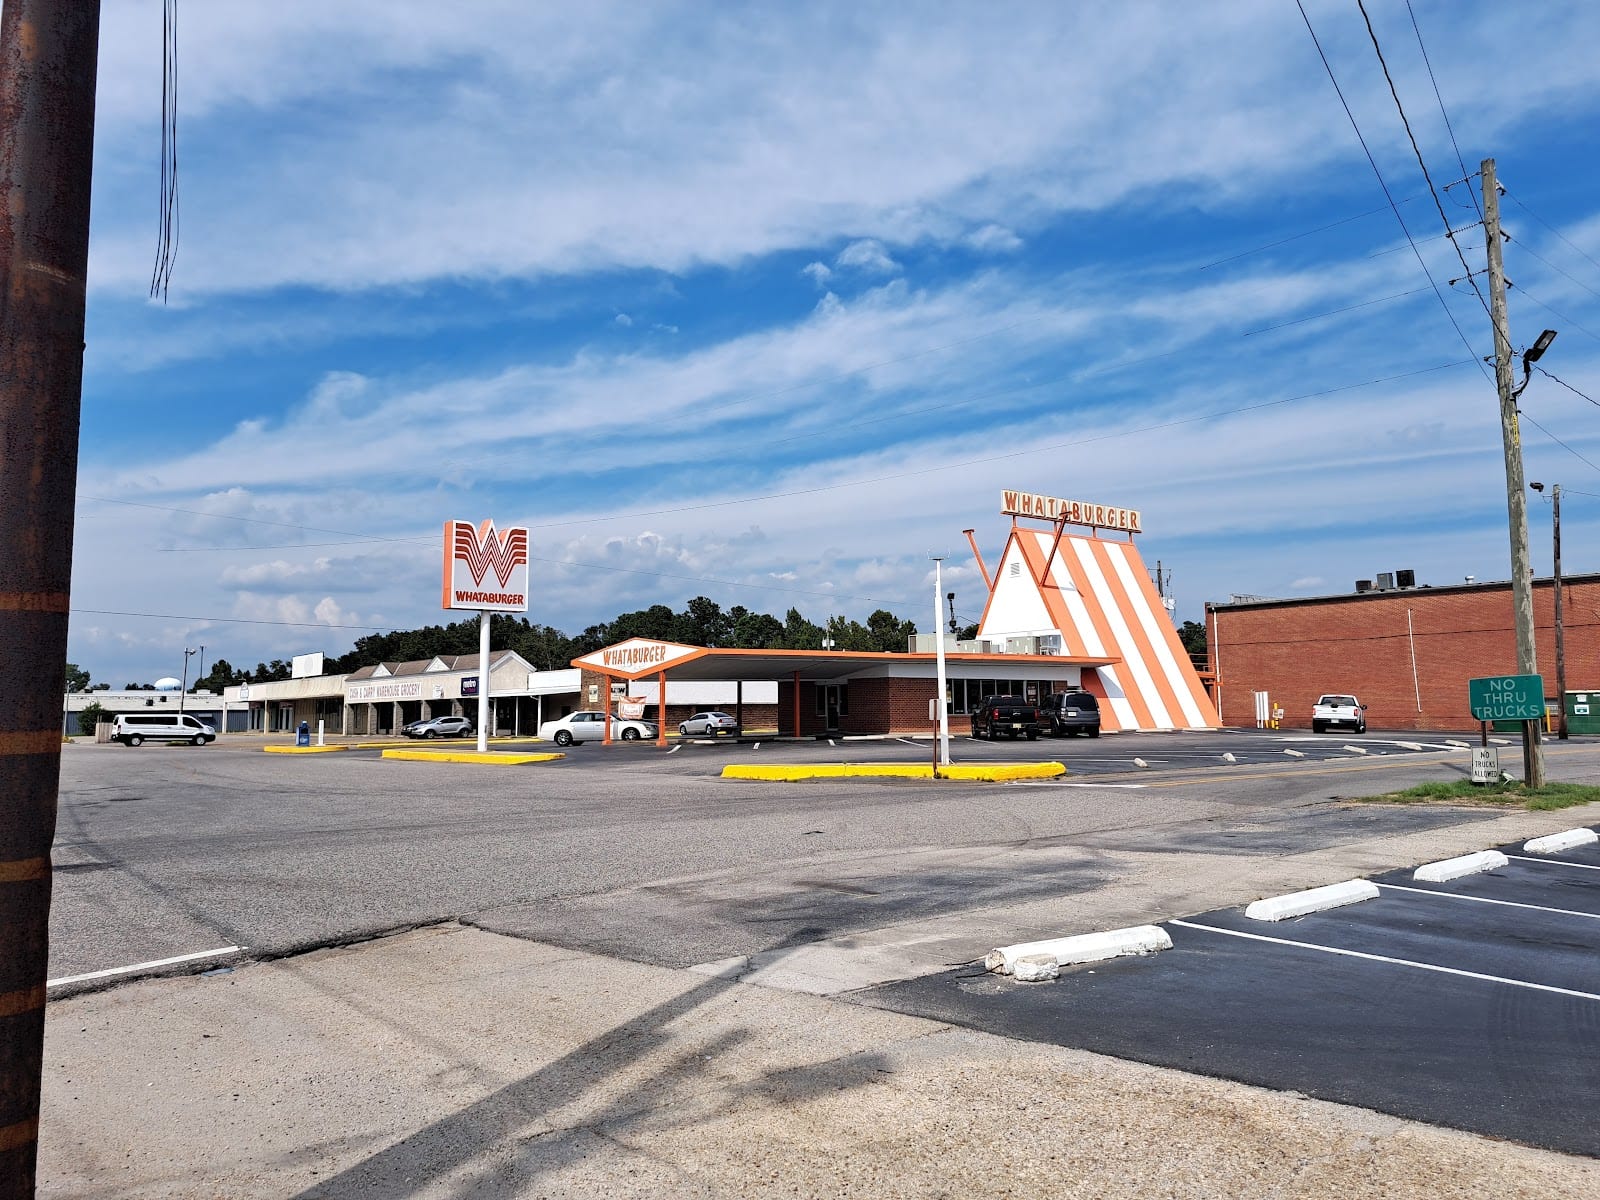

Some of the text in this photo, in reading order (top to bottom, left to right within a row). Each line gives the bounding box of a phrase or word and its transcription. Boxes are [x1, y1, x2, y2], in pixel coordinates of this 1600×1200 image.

[1004, 491, 1138, 529] WHATABURGER
[455, 590, 524, 605] WHATABURGER
[603, 645, 666, 666] WHATABURGER
[400, 683, 420, 697] GROCERY
[1490, 679, 1516, 691] NO
[1483, 692, 1527, 705] THRU
[1474, 704, 1540, 718] TRUCKS
[1480, 751, 1490, 759] NO
[1474, 760, 1496, 768] TRUCKS
[1474, 770, 1497, 778] ALLOWED
